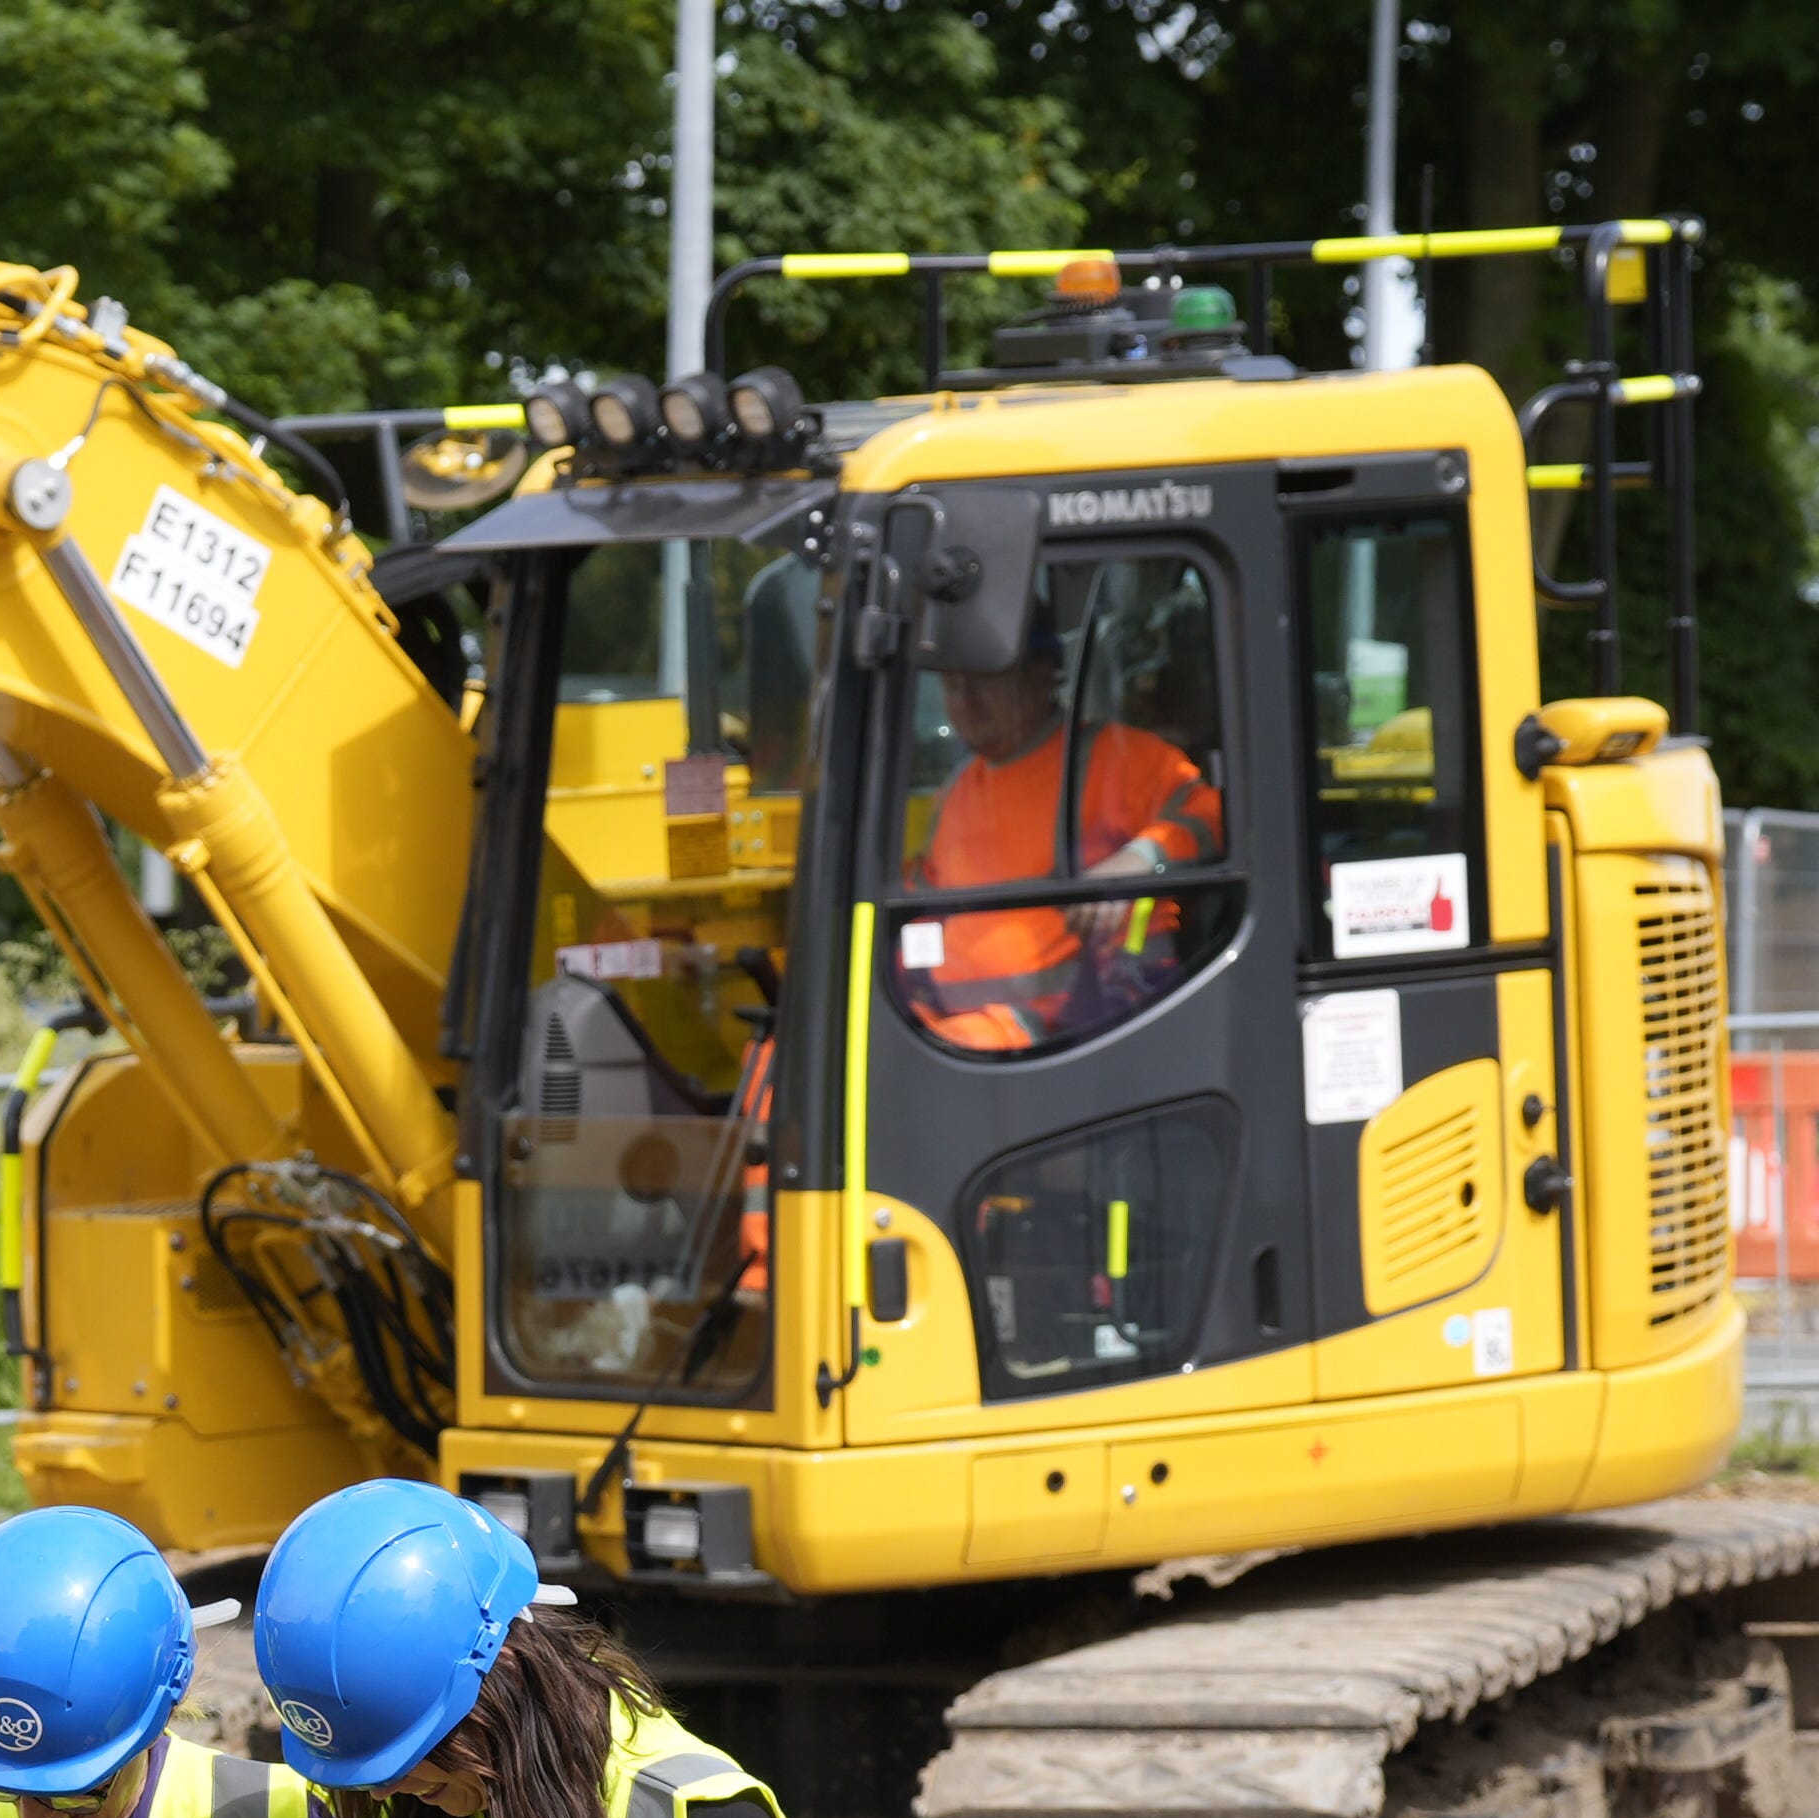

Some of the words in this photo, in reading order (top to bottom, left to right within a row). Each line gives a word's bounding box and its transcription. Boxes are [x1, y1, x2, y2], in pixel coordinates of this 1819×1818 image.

[1049, 480, 1213, 526] KOMATSU
[151, 502, 262, 592] E1312
[119, 551, 249, 652] F11694
[285, 1708, 331, 1745] i&g
